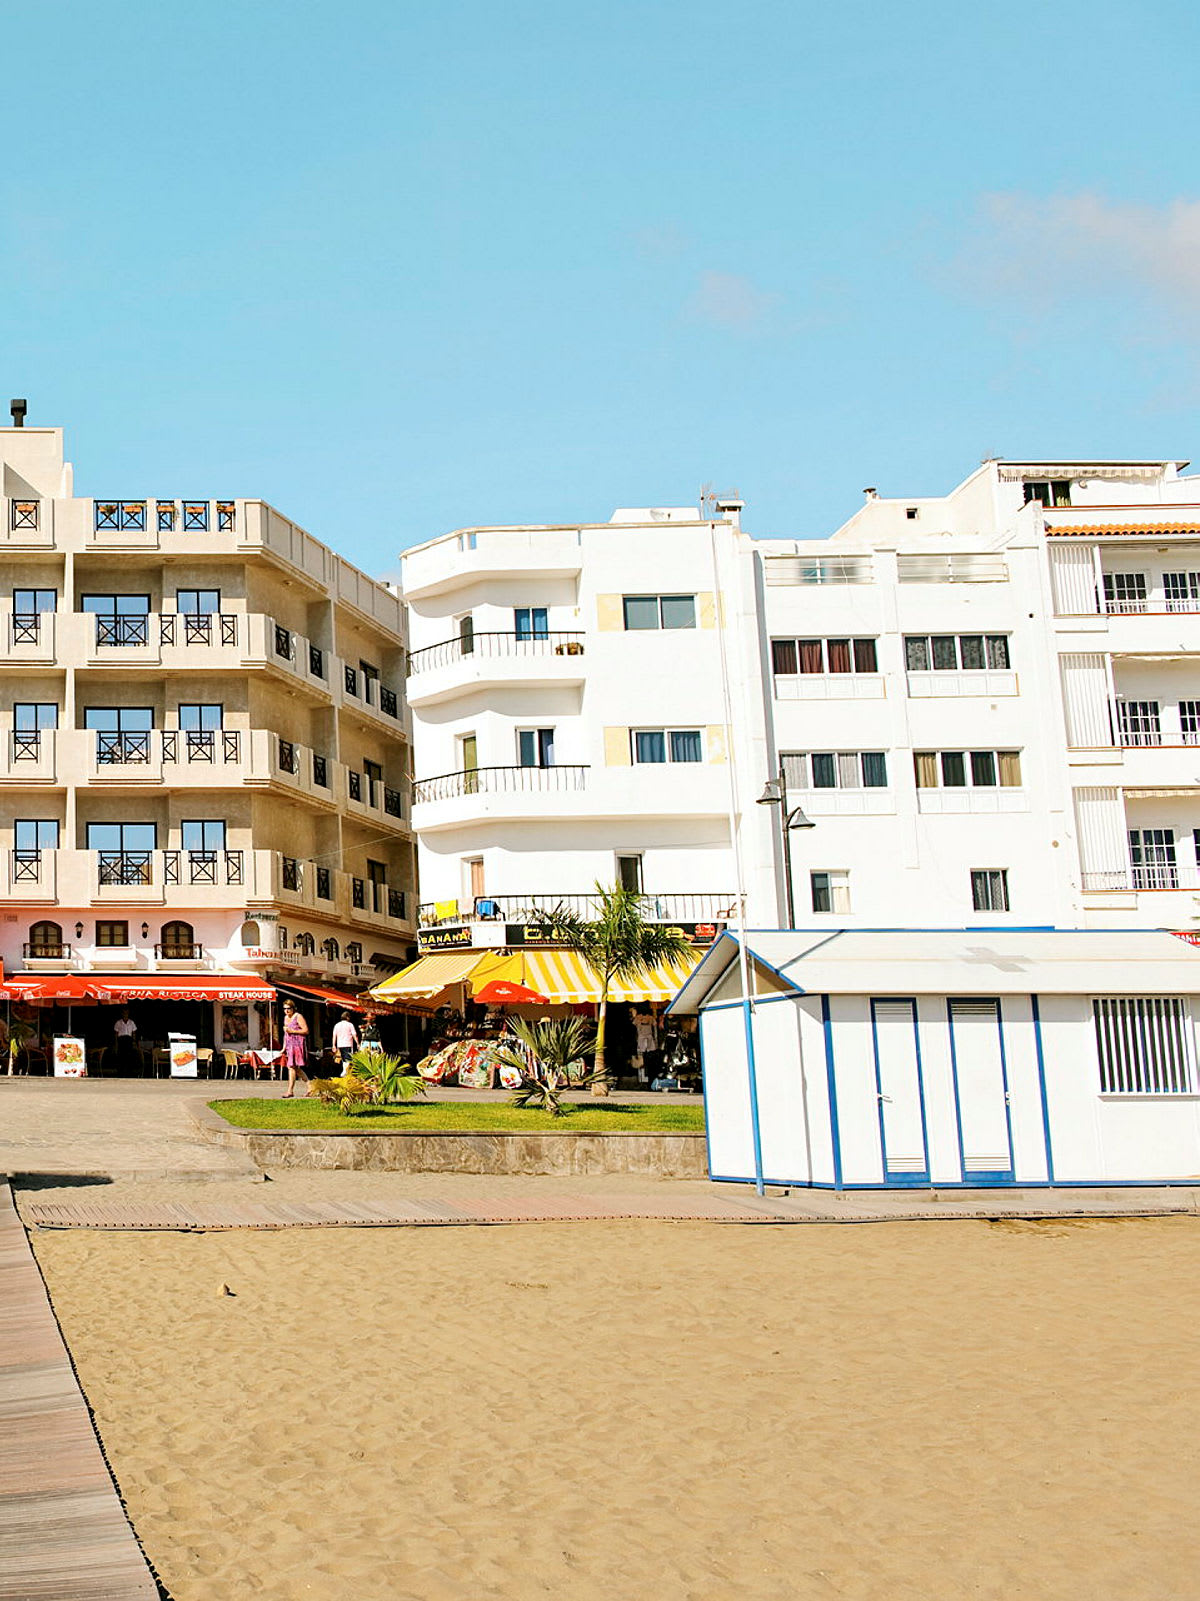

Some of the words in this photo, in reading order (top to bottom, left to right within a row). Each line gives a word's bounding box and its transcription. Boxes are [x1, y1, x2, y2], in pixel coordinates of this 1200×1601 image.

[421, 932, 468, 944] BANANA
[218, 991, 244, 999] STEAK
[246, 991, 273, 999] HOUSE
